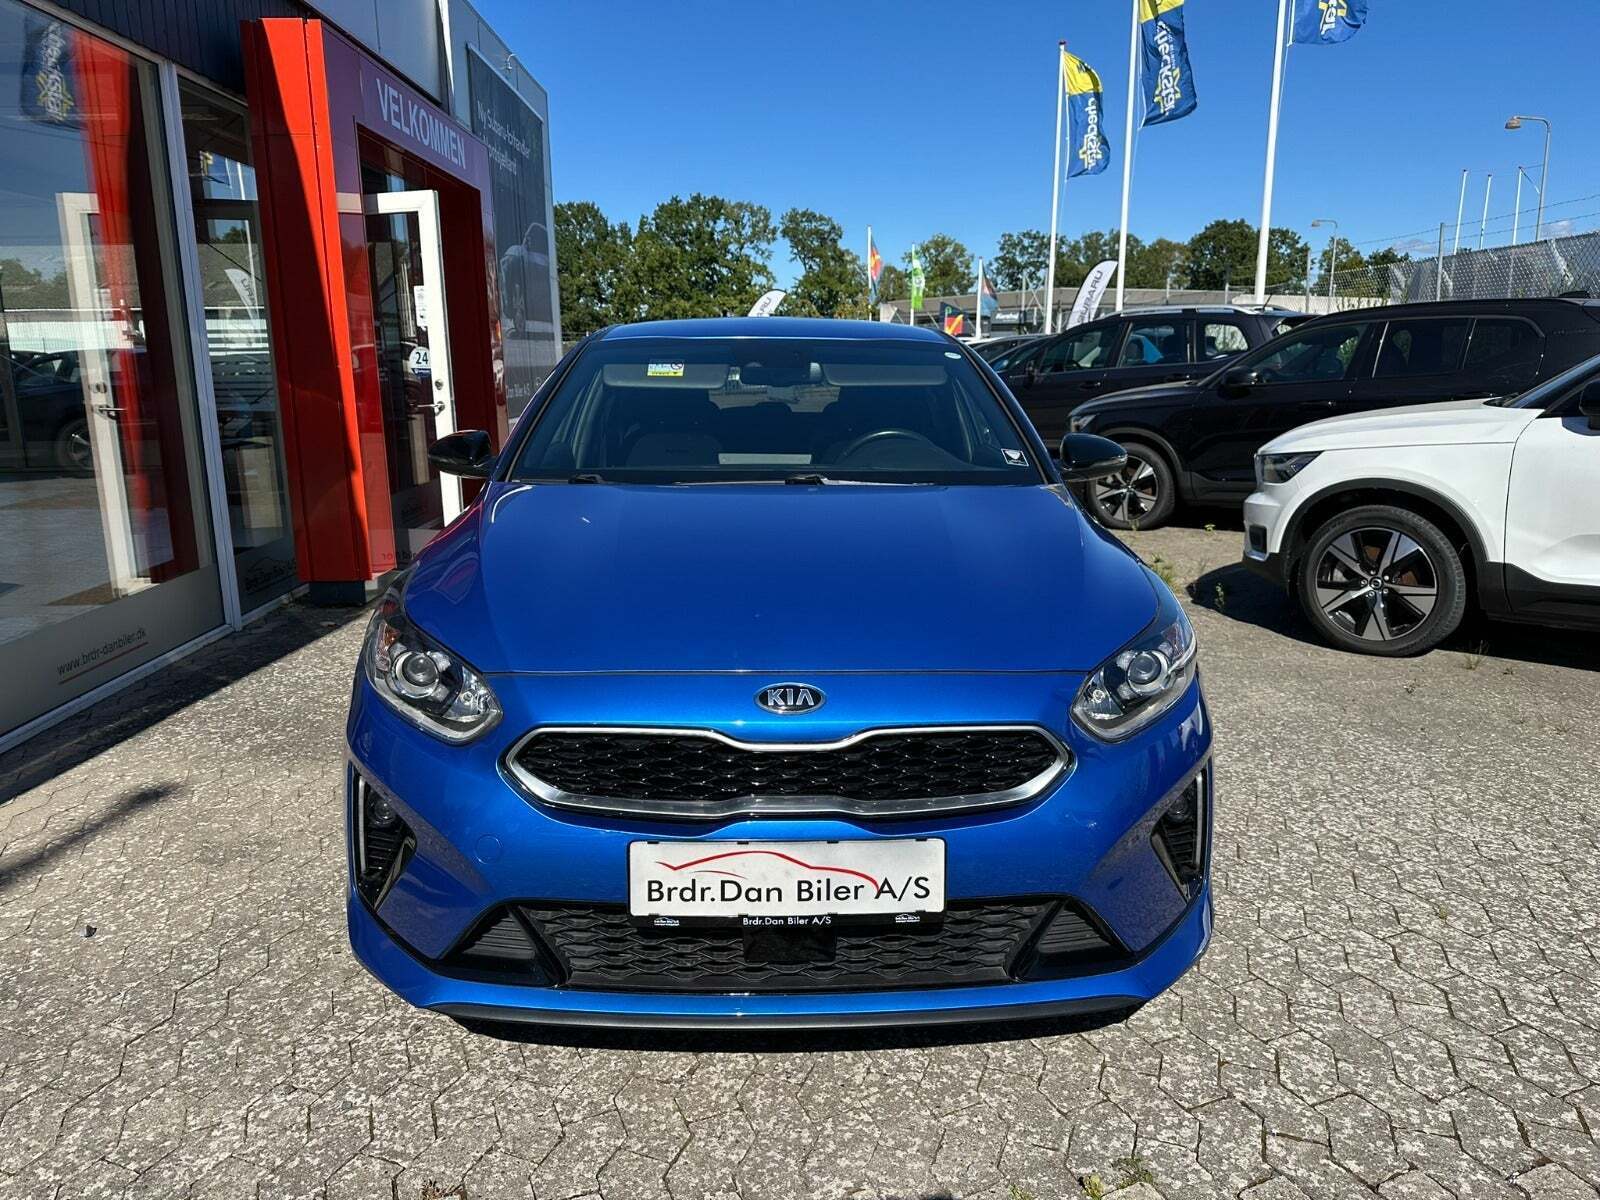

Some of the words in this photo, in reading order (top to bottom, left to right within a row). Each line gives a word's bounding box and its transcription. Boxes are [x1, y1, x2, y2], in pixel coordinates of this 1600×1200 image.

[376, 78, 466, 170] VELKOMMEN
[1077, 270, 1104, 323] SUBARU
[415, 351, 429, 365] 24
[767, 688, 815, 706] KIA
[647, 879, 783, 903] Brdr.Dan
[797, 877, 865, 902] Biler
[874, 876, 931, 902] A/S
[742, 917, 784, 926] Brdr.Dan
[787, 916, 809, 925] Biler
[812, 916, 832, 926] A/S
